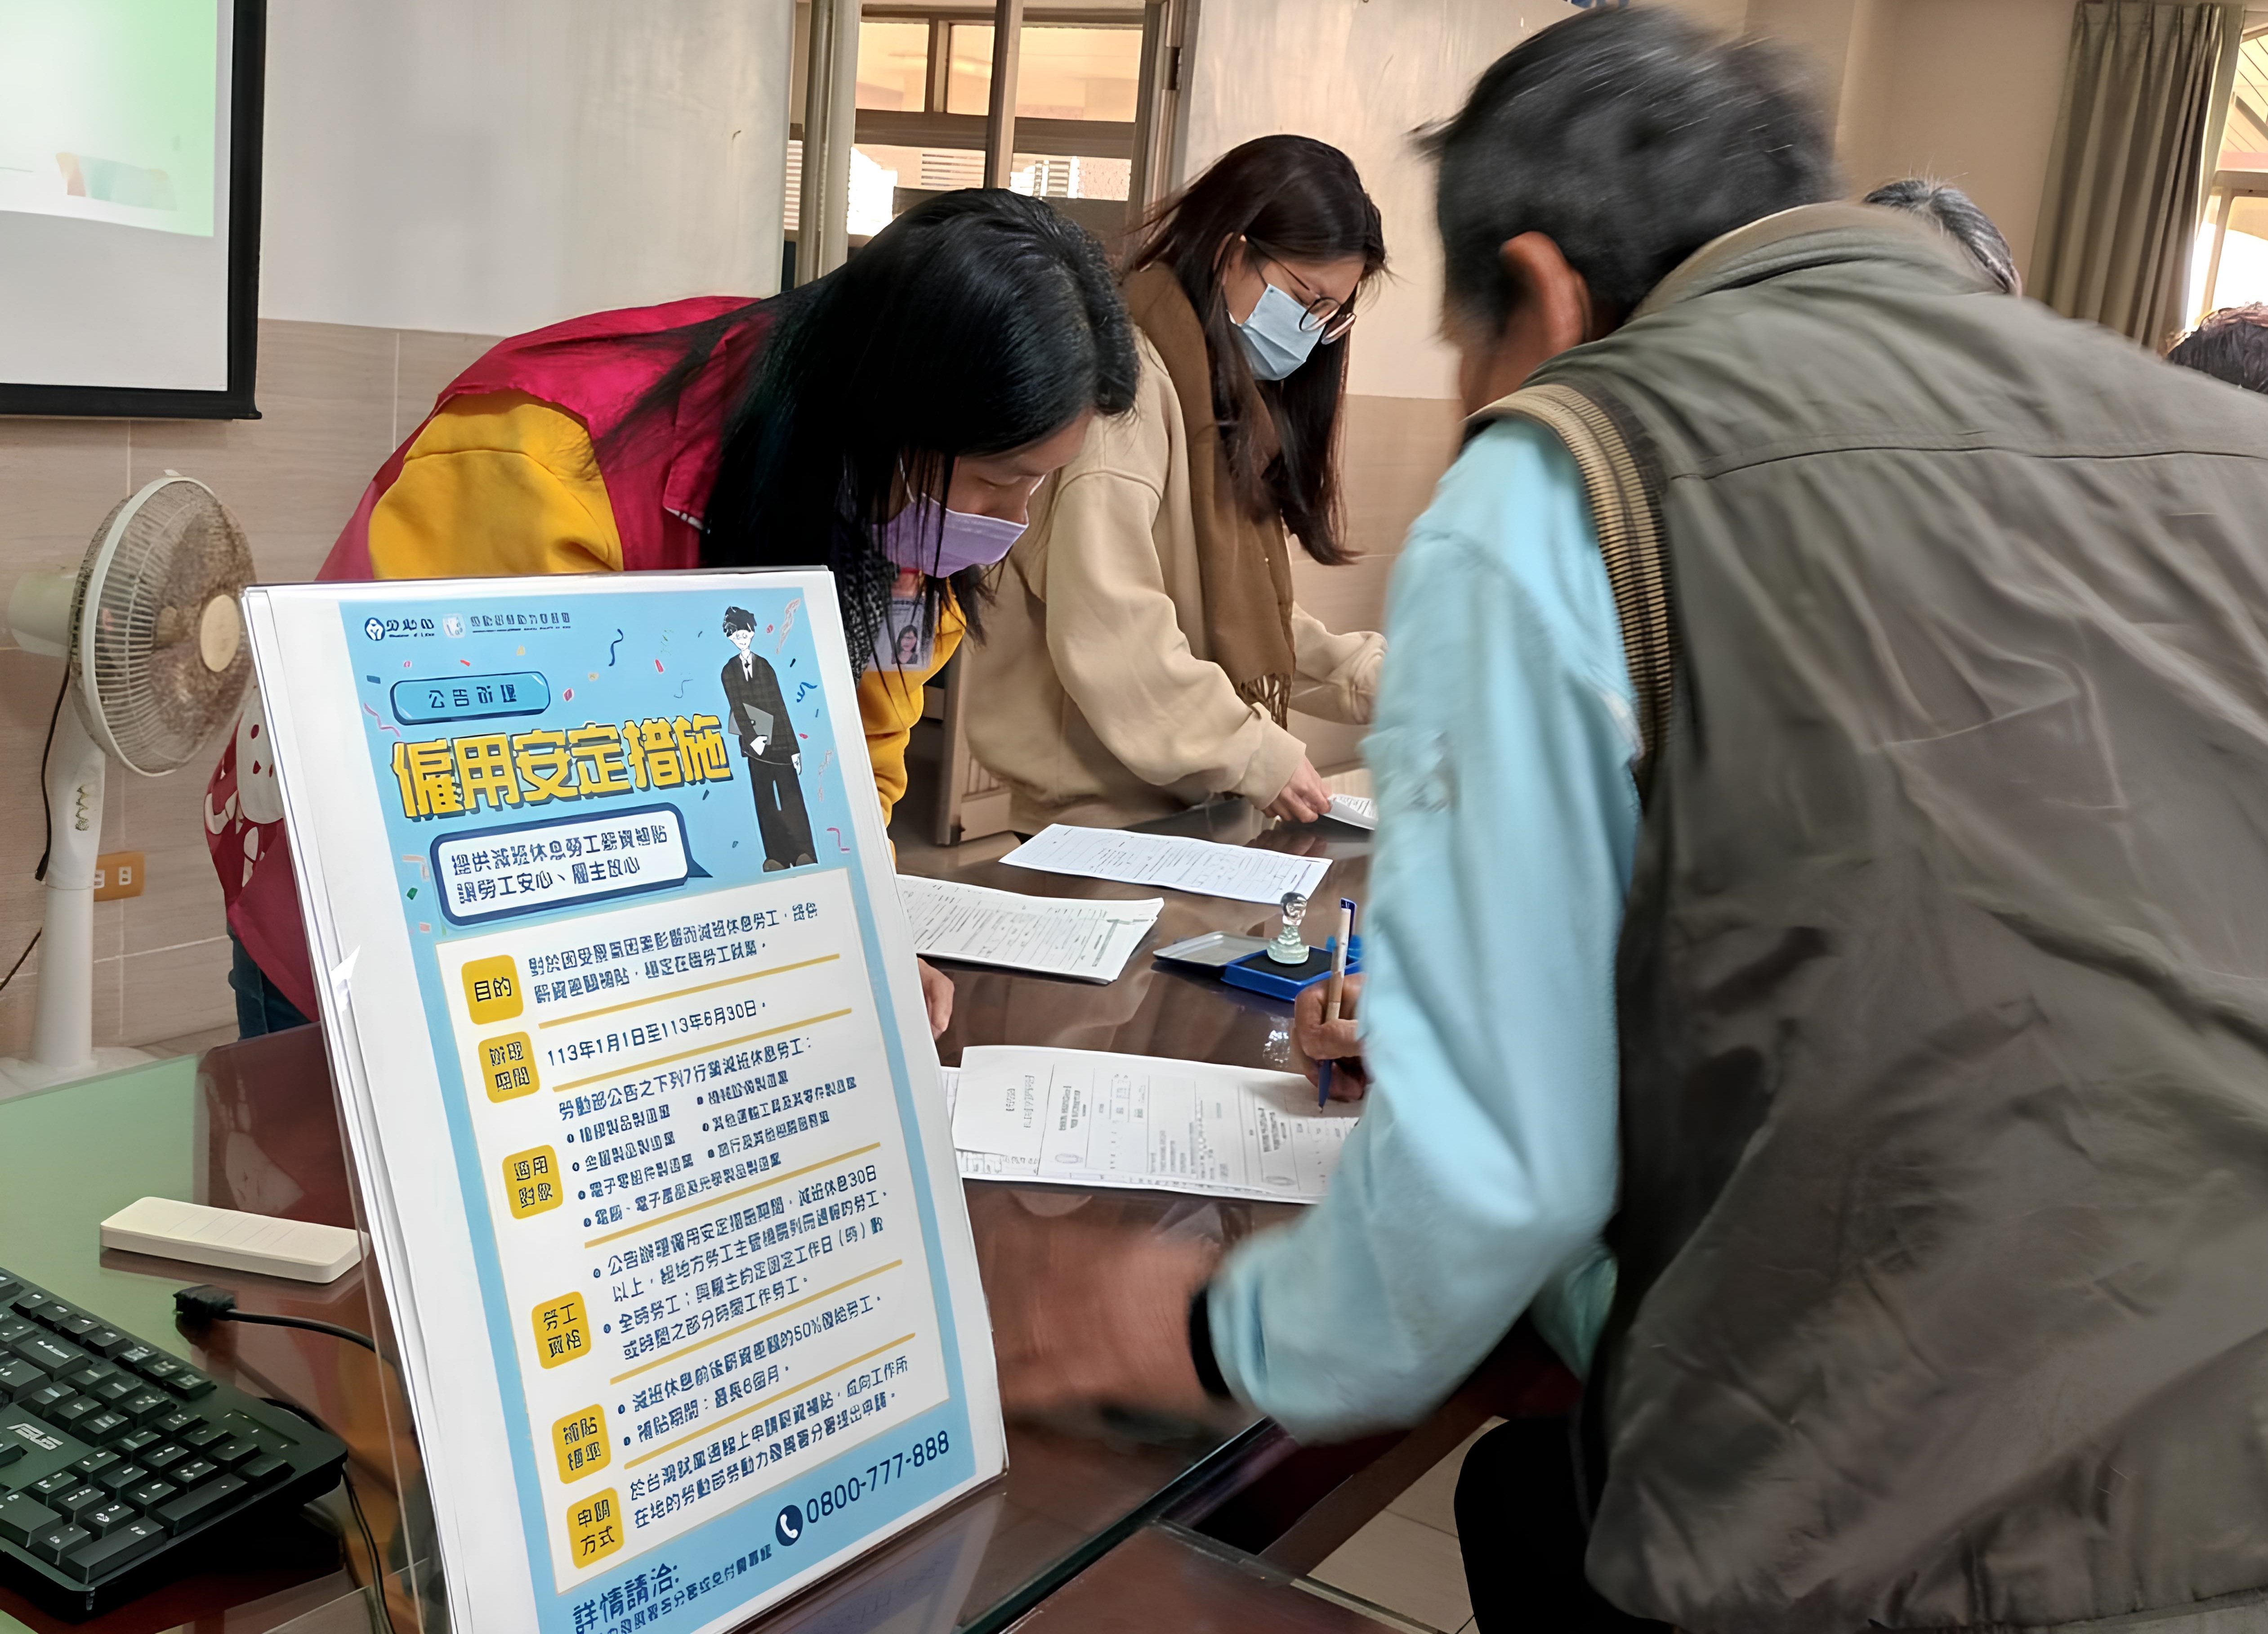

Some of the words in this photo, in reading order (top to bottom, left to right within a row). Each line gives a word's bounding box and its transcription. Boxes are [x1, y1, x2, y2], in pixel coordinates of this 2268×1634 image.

[390, 713, 734, 821] 僱用安定措施
[474, 976, 512, 1003] 目的
[806, 1430, 950, 1524] 0800-777-888
[580, 1525, 615, 1556] 方式
